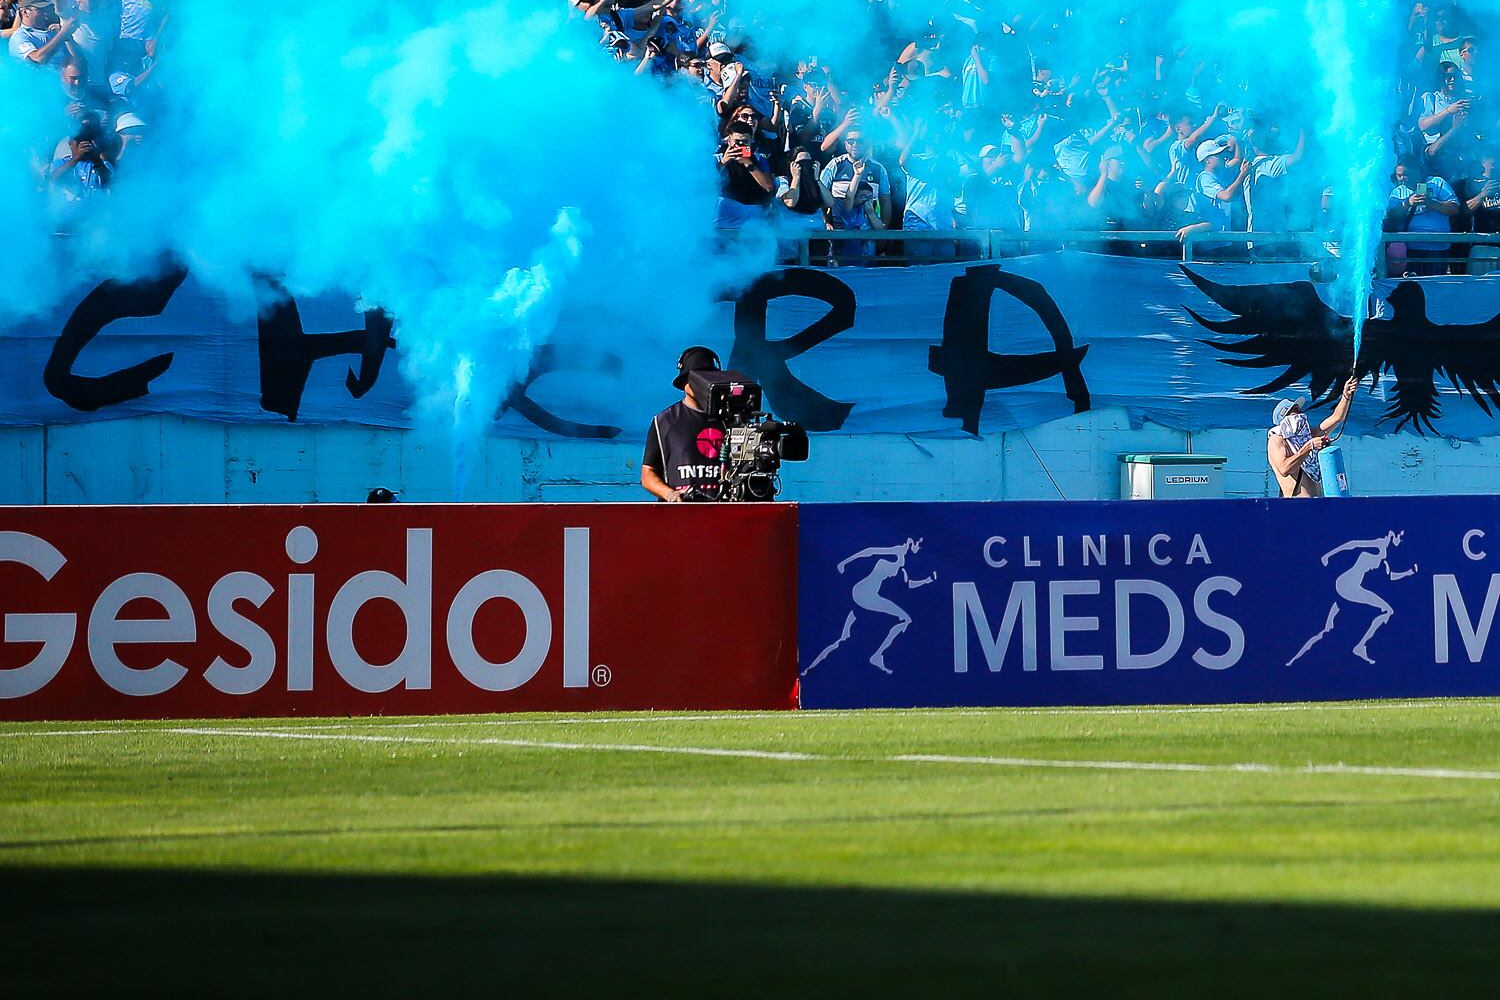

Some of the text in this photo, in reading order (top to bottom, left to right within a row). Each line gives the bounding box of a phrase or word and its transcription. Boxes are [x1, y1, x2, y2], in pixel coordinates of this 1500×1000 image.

[1166, 476, 1209, 485] LEDRIUM
[983, 533, 1212, 568] CLINICA
[951, 575, 1246, 673] MEDS
